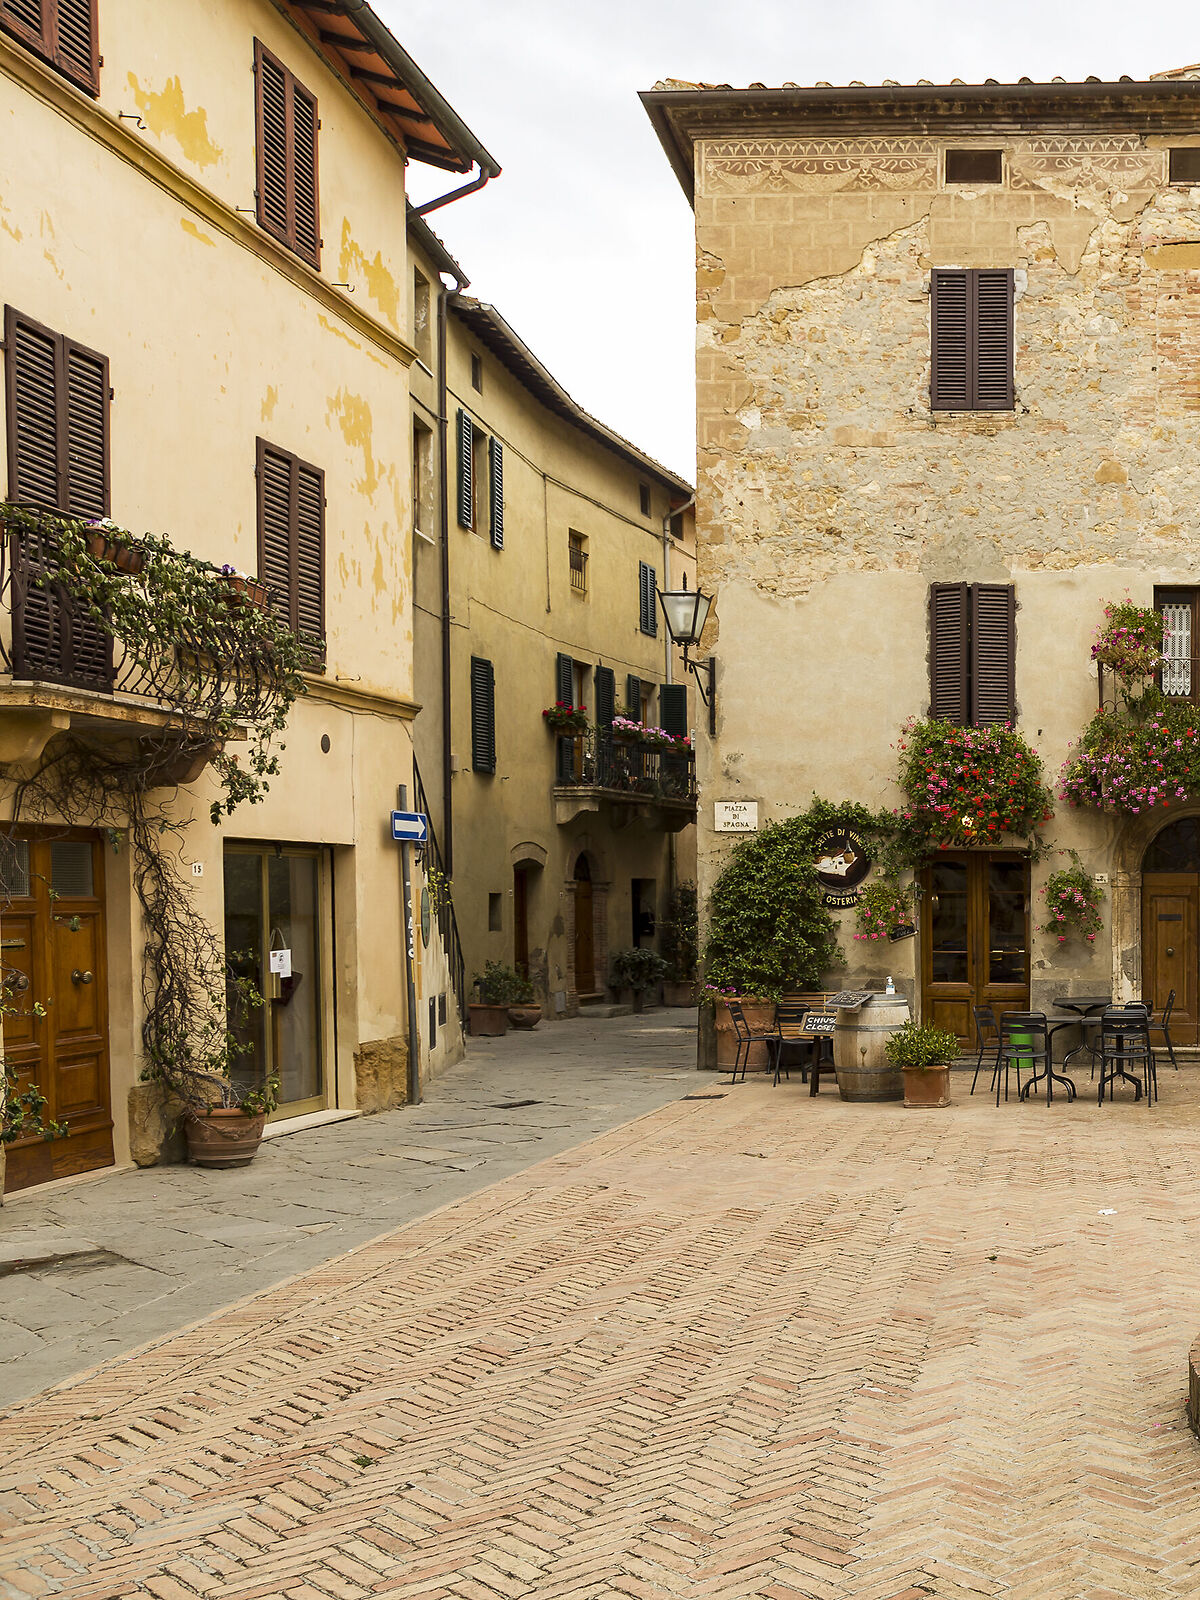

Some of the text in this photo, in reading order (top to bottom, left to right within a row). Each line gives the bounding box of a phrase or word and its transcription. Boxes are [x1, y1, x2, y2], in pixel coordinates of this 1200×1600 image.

[815, 830, 835, 847] SETTE
[837, 828, 846, 836] DI
[193, 865, 202, 874] 15
[826, 895, 858, 906] OSTERIA
